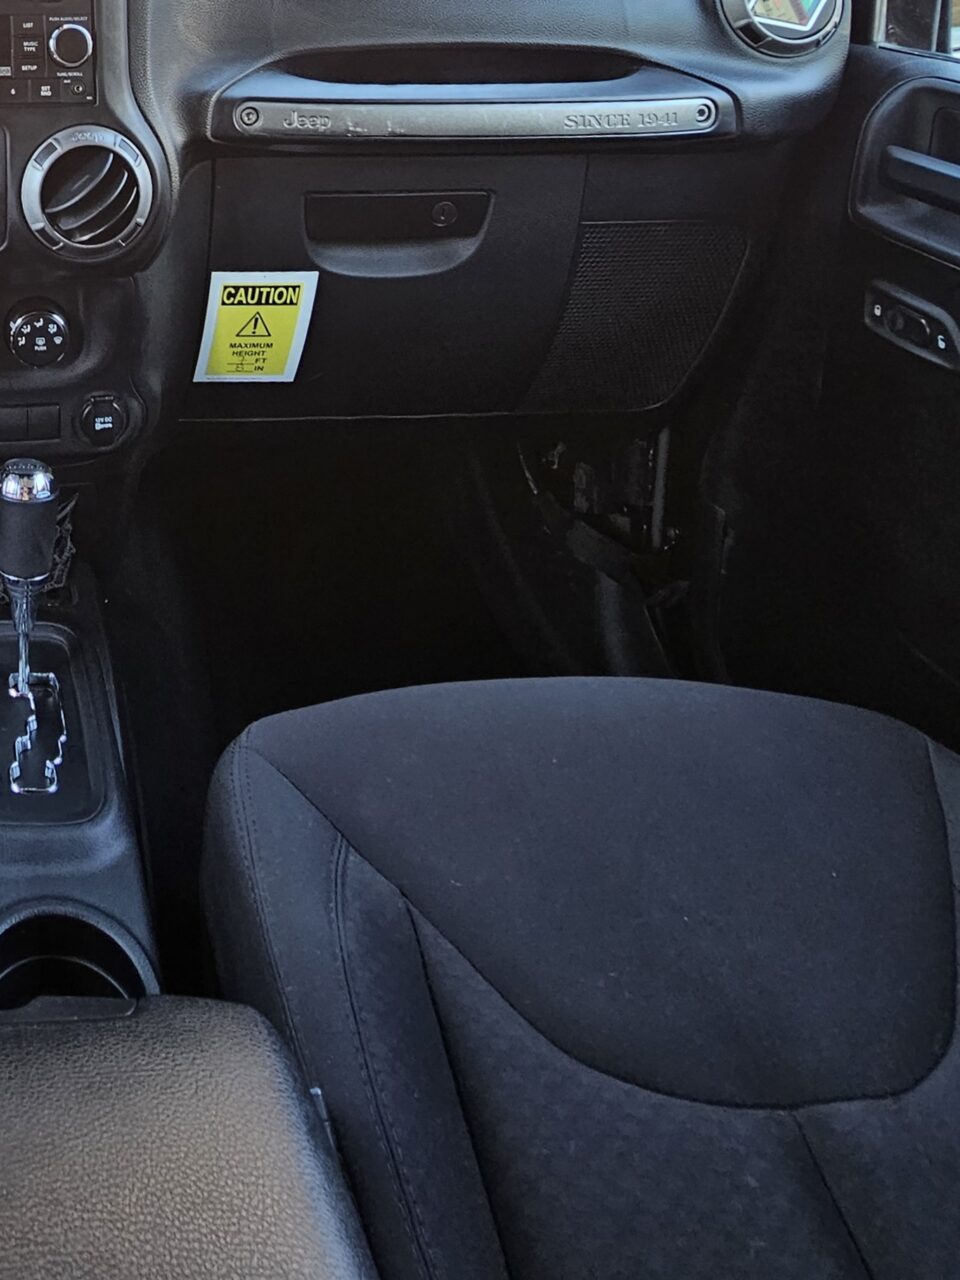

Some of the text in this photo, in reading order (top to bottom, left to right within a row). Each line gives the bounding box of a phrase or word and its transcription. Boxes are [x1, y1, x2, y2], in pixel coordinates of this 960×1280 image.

[283, 110, 332, 132] Jeep
[564, 111, 679, 129] SINCE 1941
[222, 287, 300, 305] CAUTION
